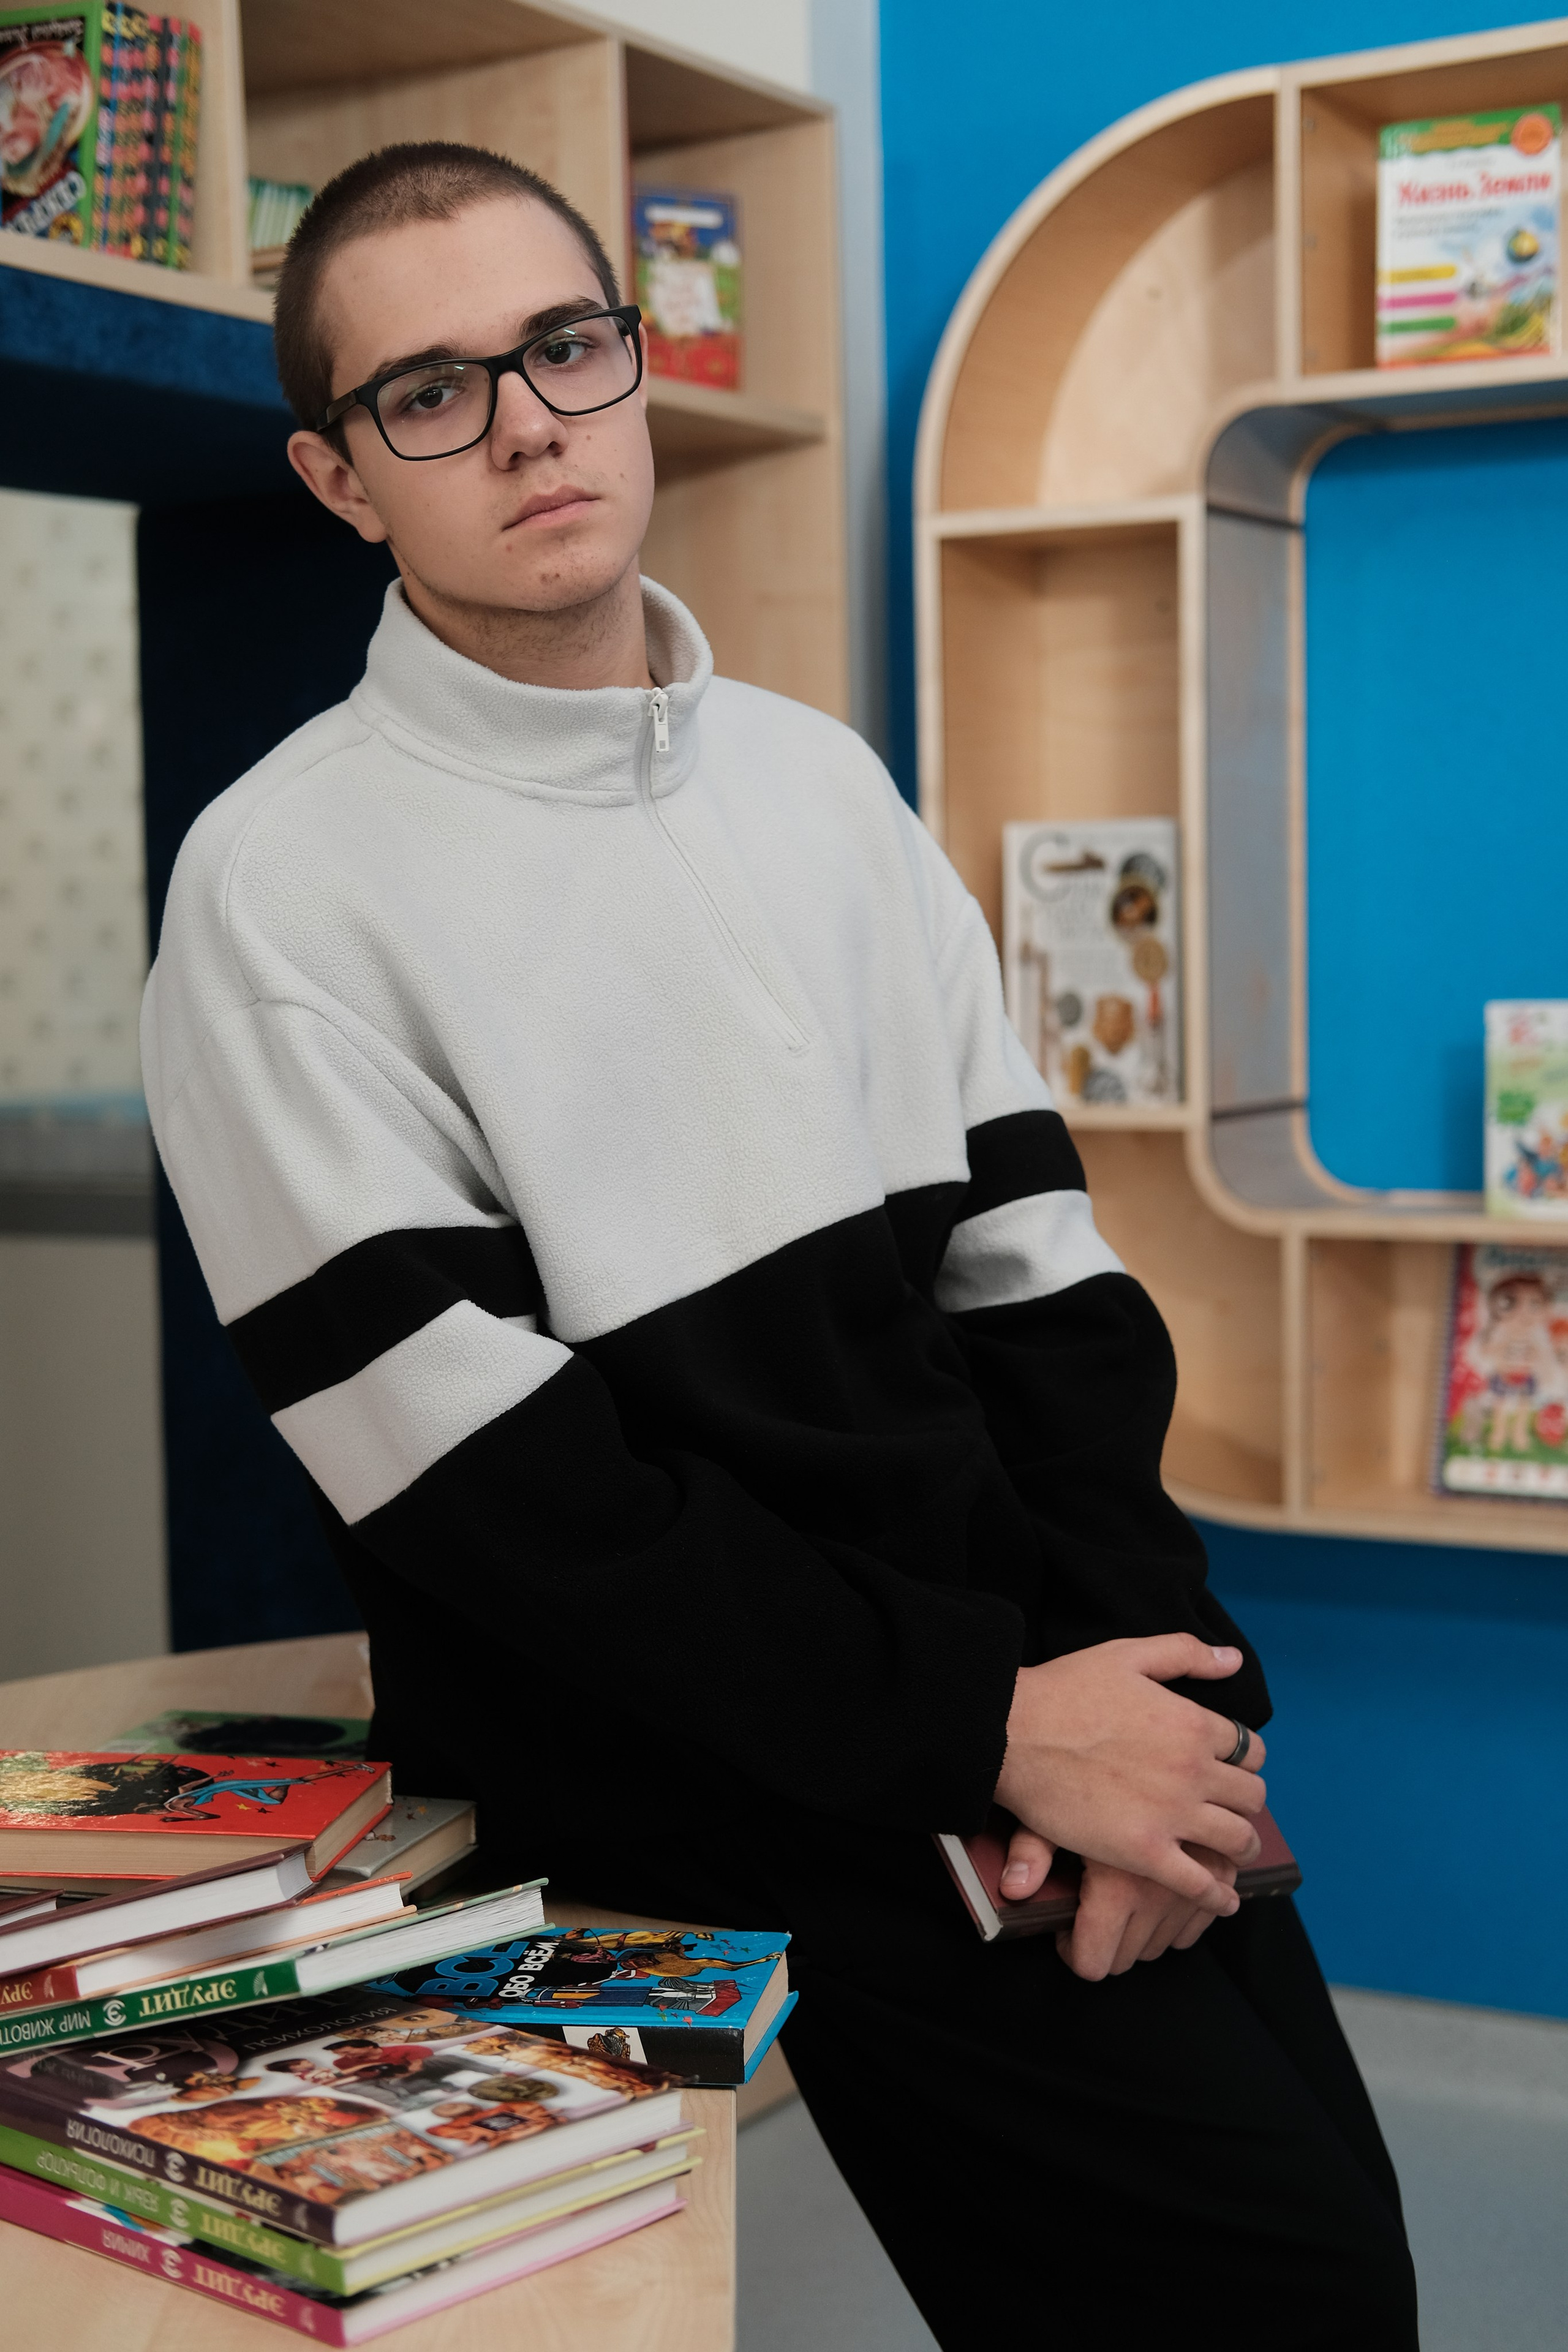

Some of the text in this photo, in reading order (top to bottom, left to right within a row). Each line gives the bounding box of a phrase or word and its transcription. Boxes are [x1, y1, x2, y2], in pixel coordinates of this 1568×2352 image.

[138, 1978, 238, 2018] ЭРУДИТ
[498, 1975, 535, 1997] ОБО
[59, 2010, 91, 2033] МИР
[243, 2005, 398, 2053] ПСИХОЛОГИЯ
[66, 2117, 156, 2168] ПСИХОЛОГИЯ
[36, 2150, 107, 2195] ФОЛЬКЛОР
[193, 2165, 283, 2217] ЭРУДИТ
[123, 2184, 159, 2213] ЯЗЫК
[102, 2227, 151, 2266] ХИМИЯ
[199, 2212, 287, 2265] ЭРУДИТ
[192, 2264, 287, 2318] ЭРУДИТ
